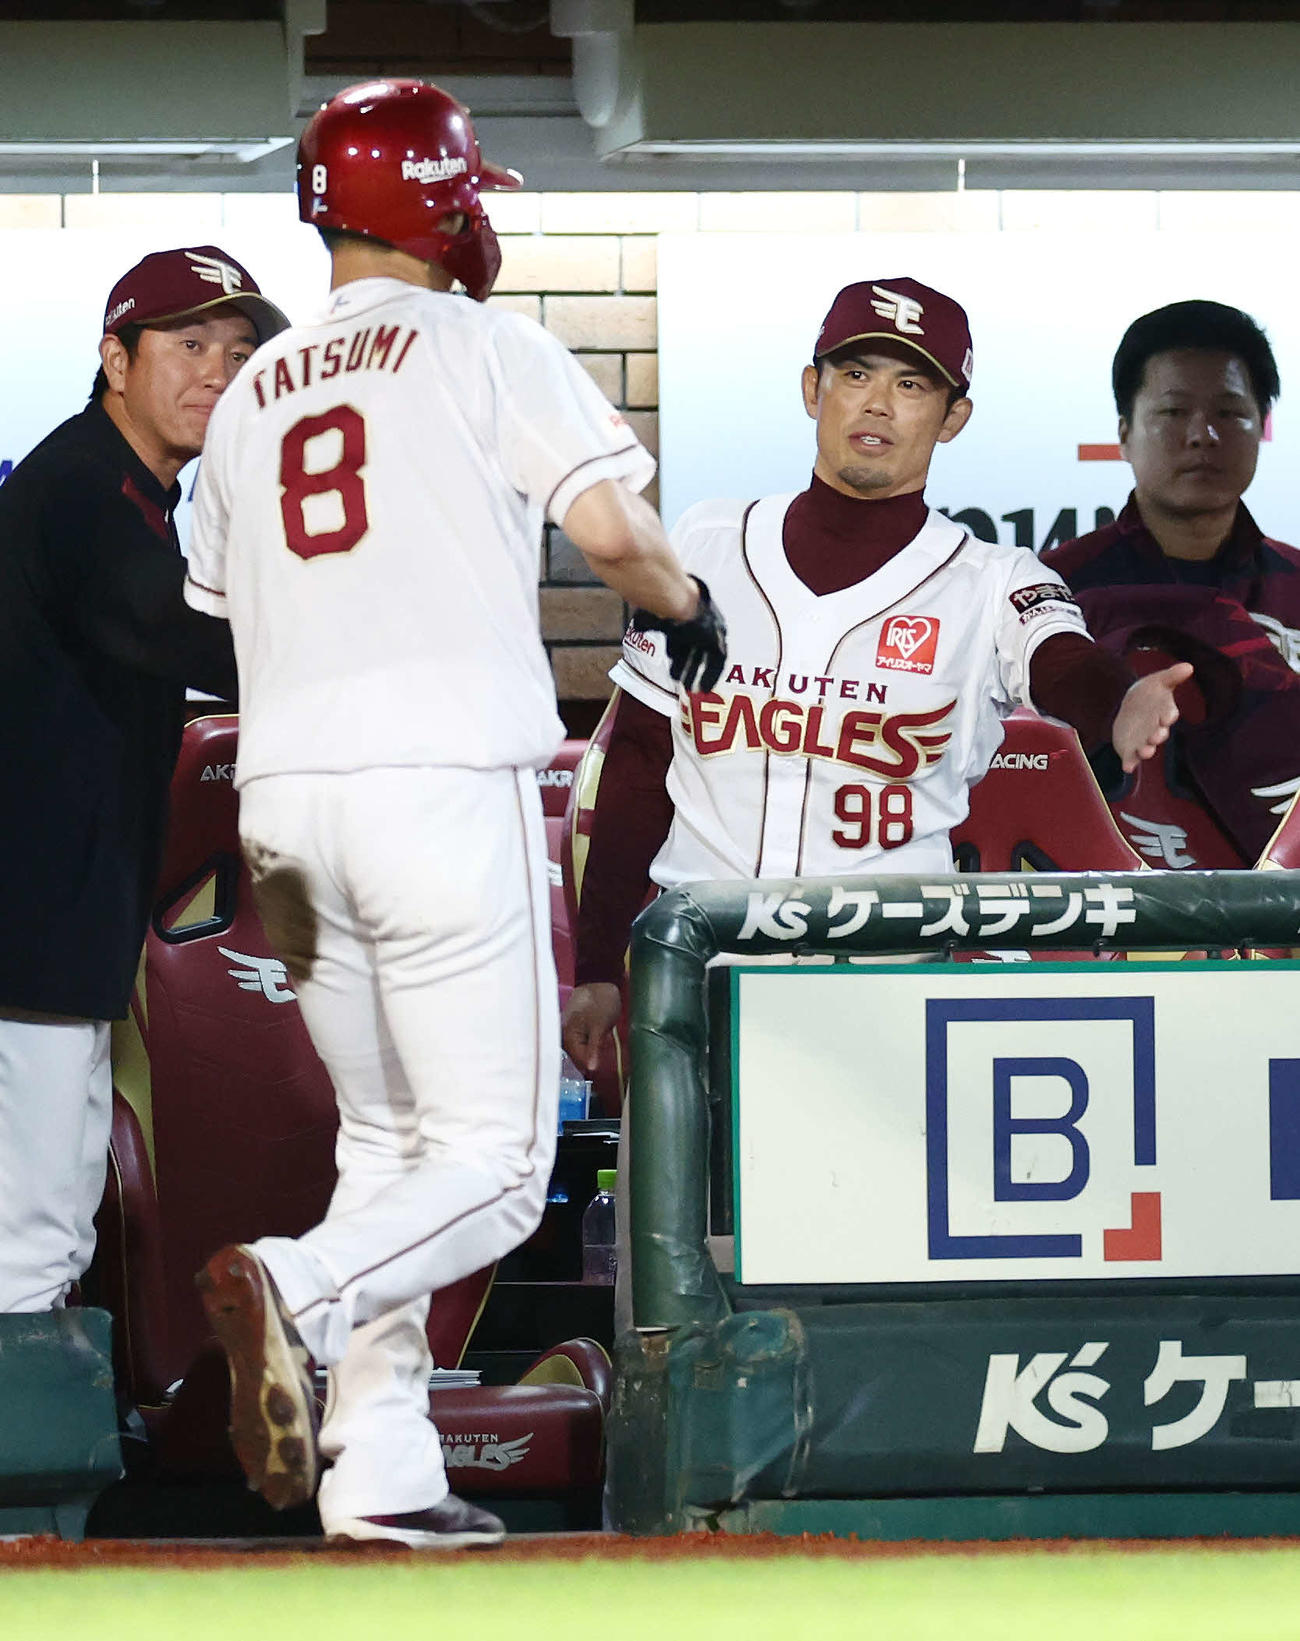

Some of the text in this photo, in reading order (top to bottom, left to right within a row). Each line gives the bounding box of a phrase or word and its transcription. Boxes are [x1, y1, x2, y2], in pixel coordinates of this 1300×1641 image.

[312, 164, 328, 194] 8
[401, 156, 467, 181] Rakuten
[253, 324, 418, 409] TATSUMI
[279, 403, 369, 561] 8
[726, 664, 888, 704] AKUTEN
[680, 692, 958, 781] EAGLES
[990, 753, 1048, 770] ACING
[832, 784, 913, 849] 98
[827, 883, 1136, 938] ケーズデンキ
[973, 1342, 1110, 1453] K's
